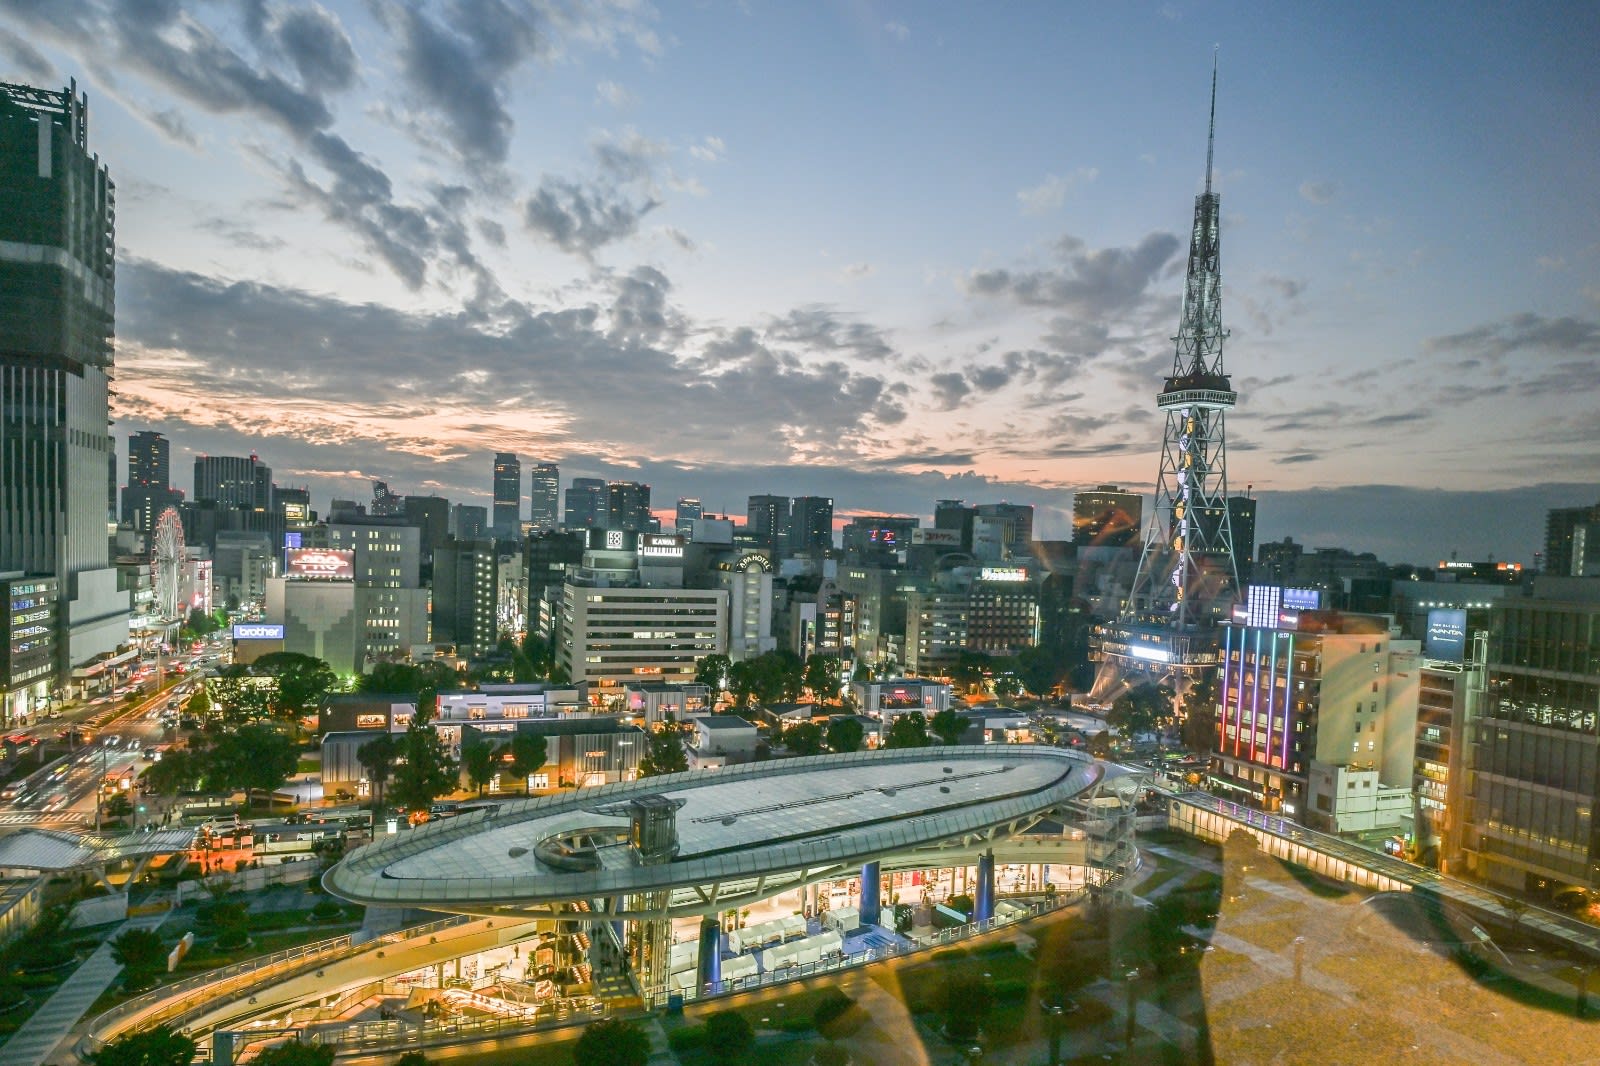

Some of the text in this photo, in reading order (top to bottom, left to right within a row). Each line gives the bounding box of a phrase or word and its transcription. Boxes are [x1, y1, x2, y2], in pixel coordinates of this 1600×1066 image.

[652, 538, 676, 546] KAWAI
[740, 554, 771, 570] APA HOTEL
[239, 627, 279, 636] brother
